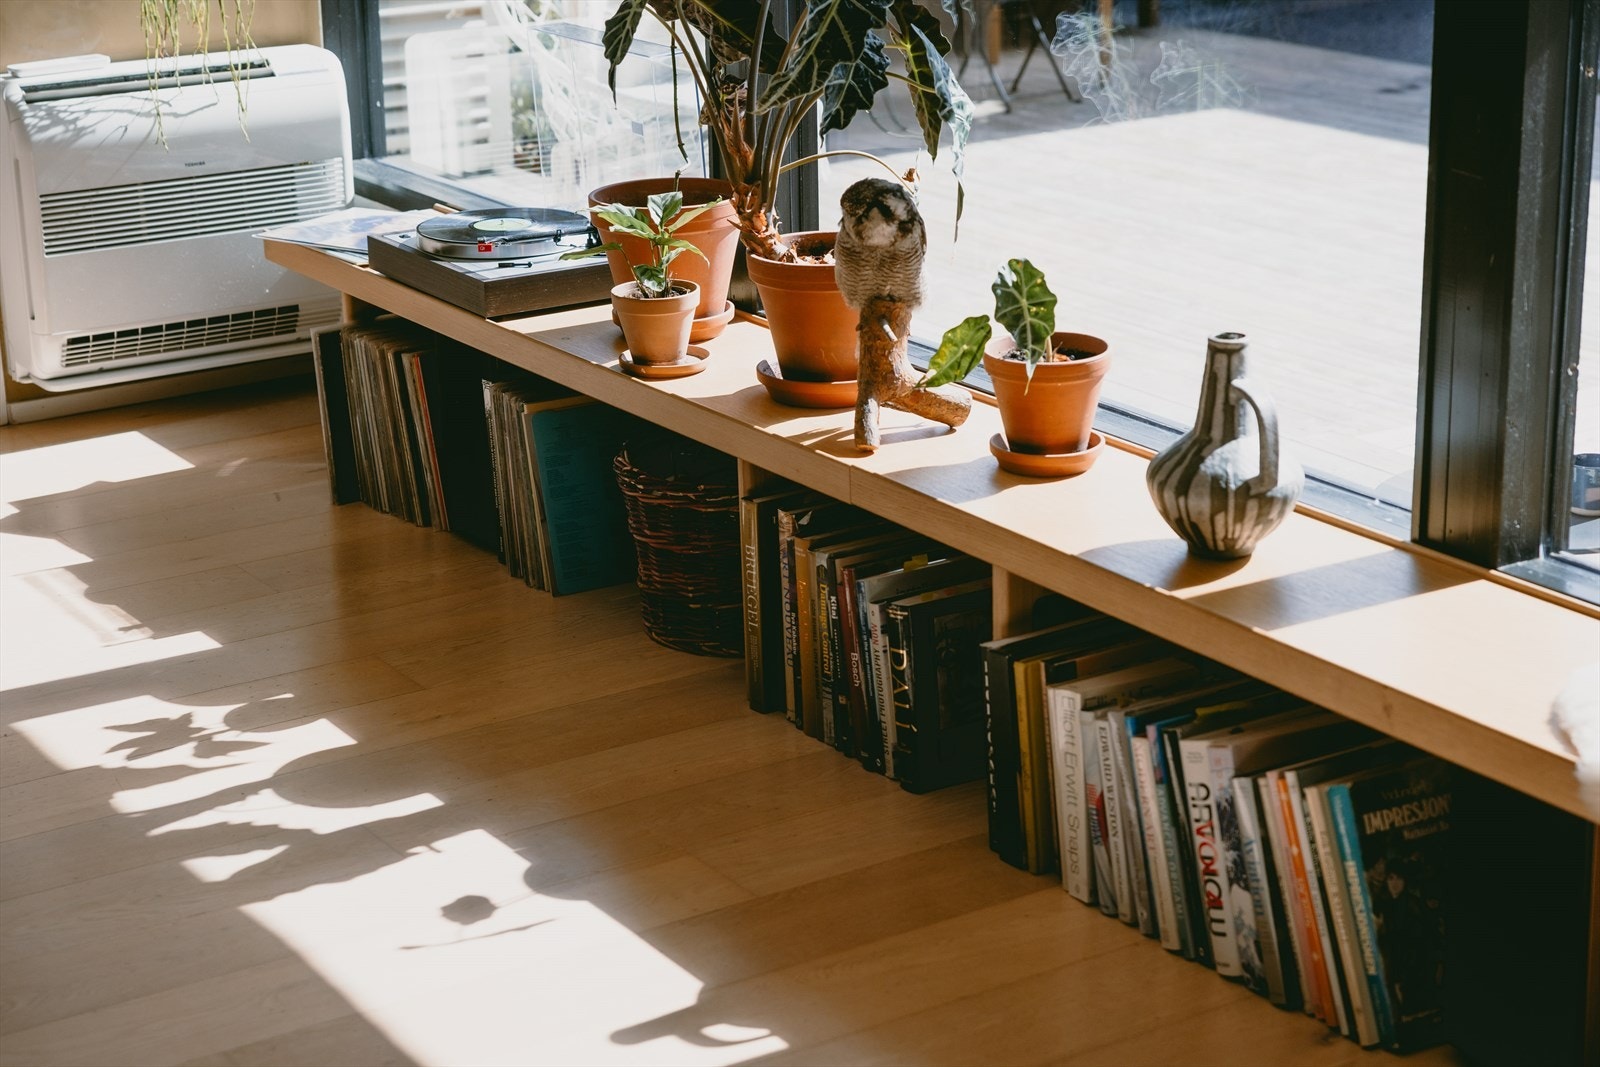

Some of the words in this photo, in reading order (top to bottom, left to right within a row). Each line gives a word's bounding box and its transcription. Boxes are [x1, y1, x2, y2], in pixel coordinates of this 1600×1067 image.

[745, 544, 759, 632] BRUEGEL
[830, 595, 839, 619] Kitaj
[783, 587, 794, 668] NOUVEAU
[822, 632, 832, 676] Control
[871, 623, 879, 646] NOW
[851, 652, 861, 687] Bosch
[873, 648, 886, 718] PHOTOGRAPHY
[1062, 695, 1075, 747] Elliott
[1064, 752, 1078, 807] Erwitt
[1099, 726, 1113, 782] EDWARD
[1104, 784, 1119, 838] WESTON
[1145, 823, 1157, 852] ART
[1067, 815, 1080, 875] Snaps
